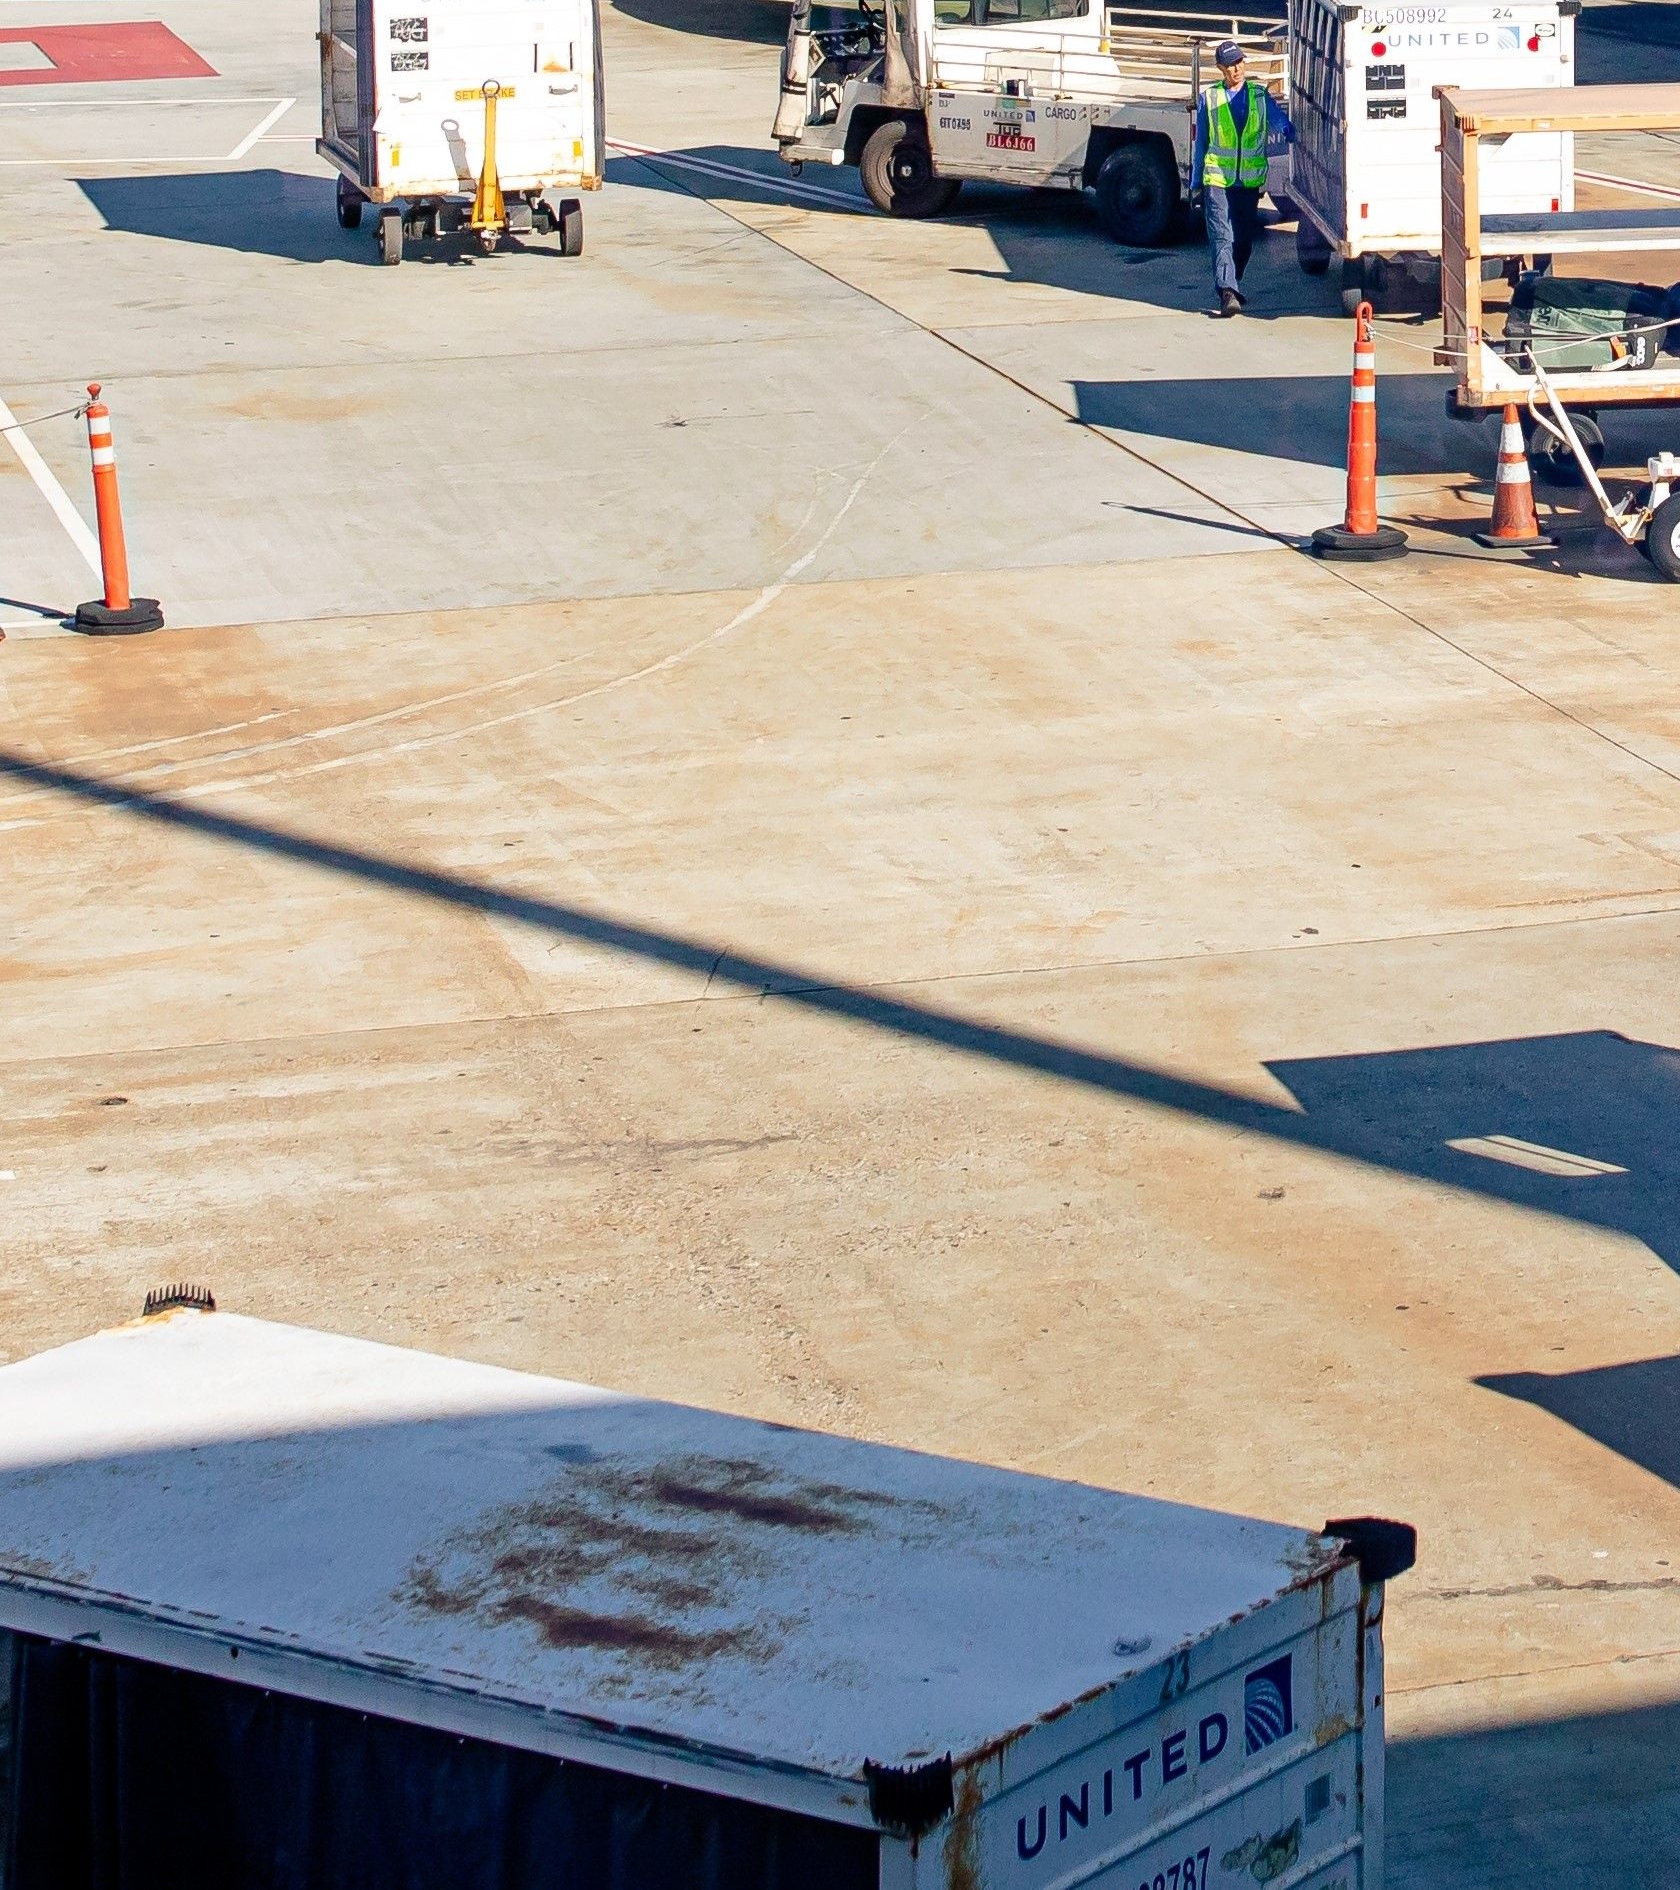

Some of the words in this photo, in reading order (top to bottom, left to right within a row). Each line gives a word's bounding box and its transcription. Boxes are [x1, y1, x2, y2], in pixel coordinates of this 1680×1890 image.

[1362, 7, 1447, 25] BC508992
[1491, 8, 1513, 19] 24
[1387, 31, 1490, 48] UNITED
[455, 89, 475, 101] SET
[983, 109, 1023, 120] UNITED
[1045, 106, 1077, 121] CARGO
[1016, 1712, 1229, 1860] UNITED
